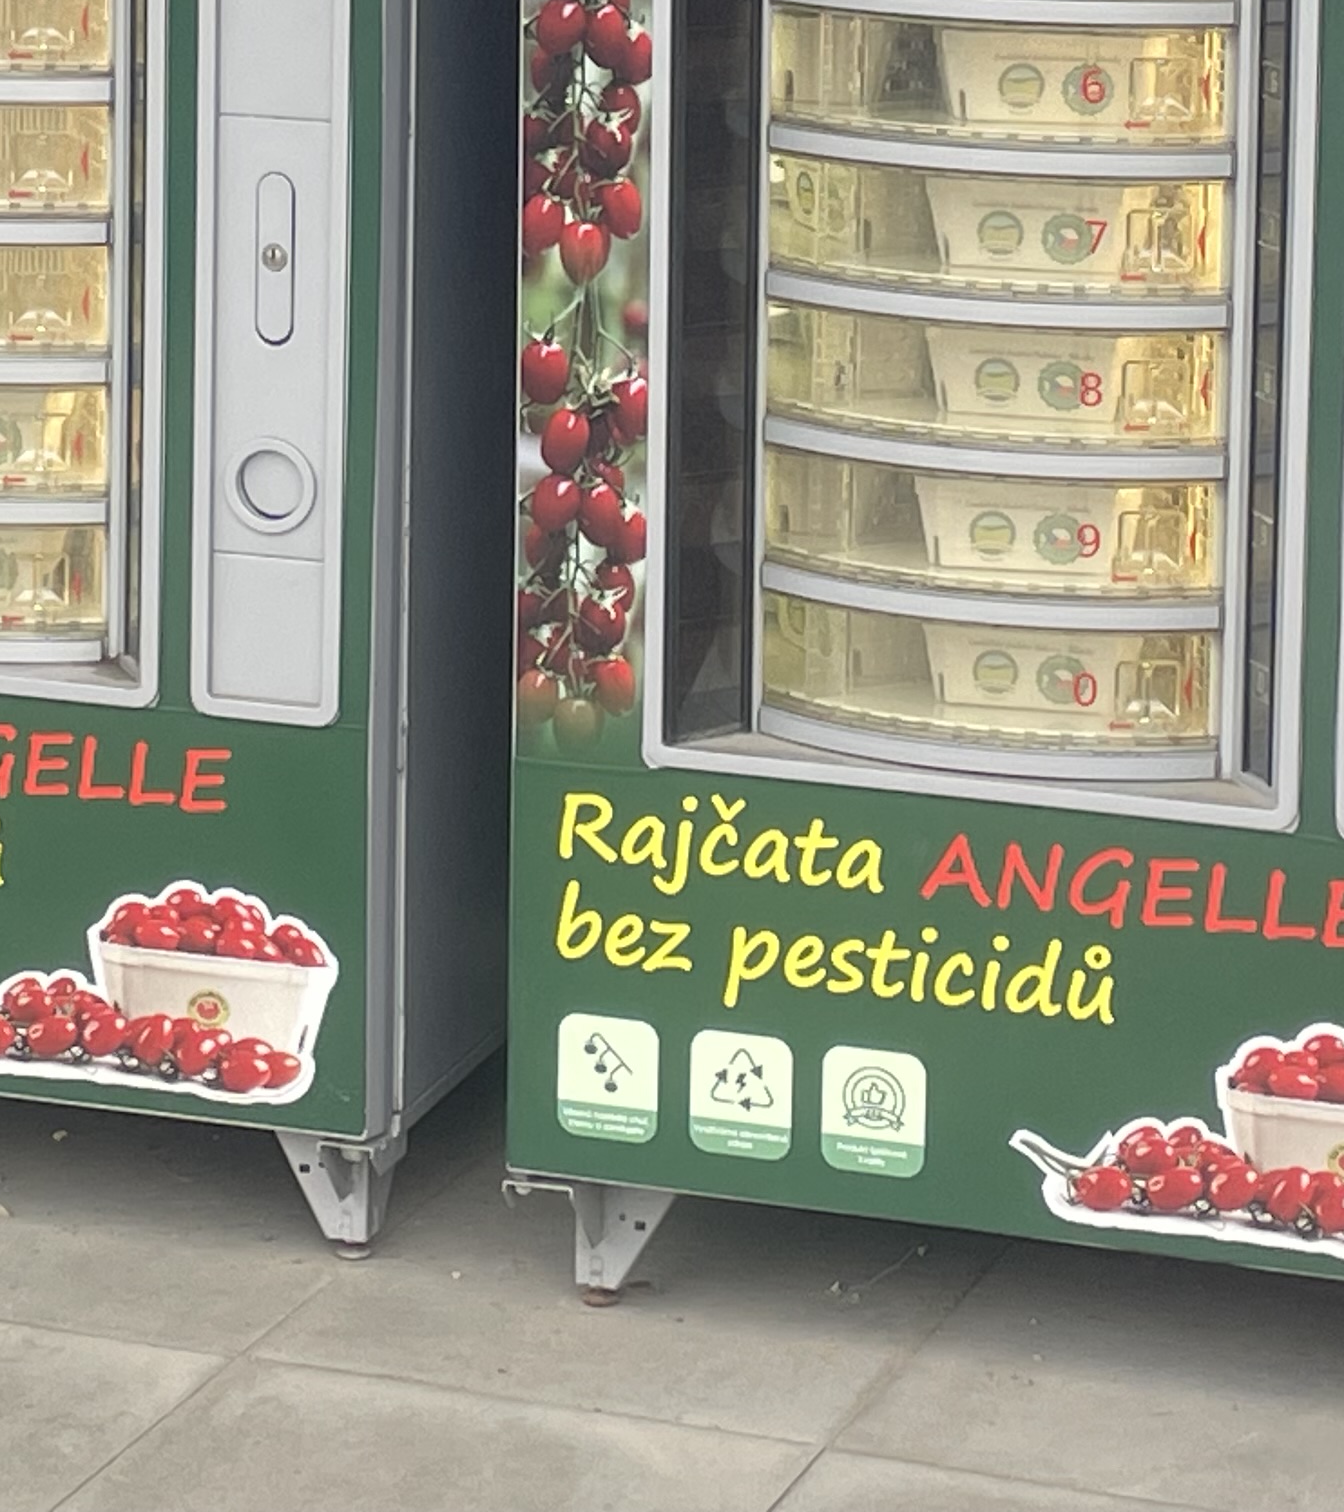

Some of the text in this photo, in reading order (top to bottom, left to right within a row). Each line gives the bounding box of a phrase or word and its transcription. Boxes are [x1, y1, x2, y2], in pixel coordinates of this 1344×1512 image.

[1080, 68, 1106, 104] 6
[1085, 220, 1108, 254] 7
[1079, 372, 1103, 407] 8
[1076, 523, 1100, 558] 9
[1072, 671, 1097, 707] 0
[558, 791, 885, 896] Rajčata
[555, 878, 1115, 1025] bez pesticidů
